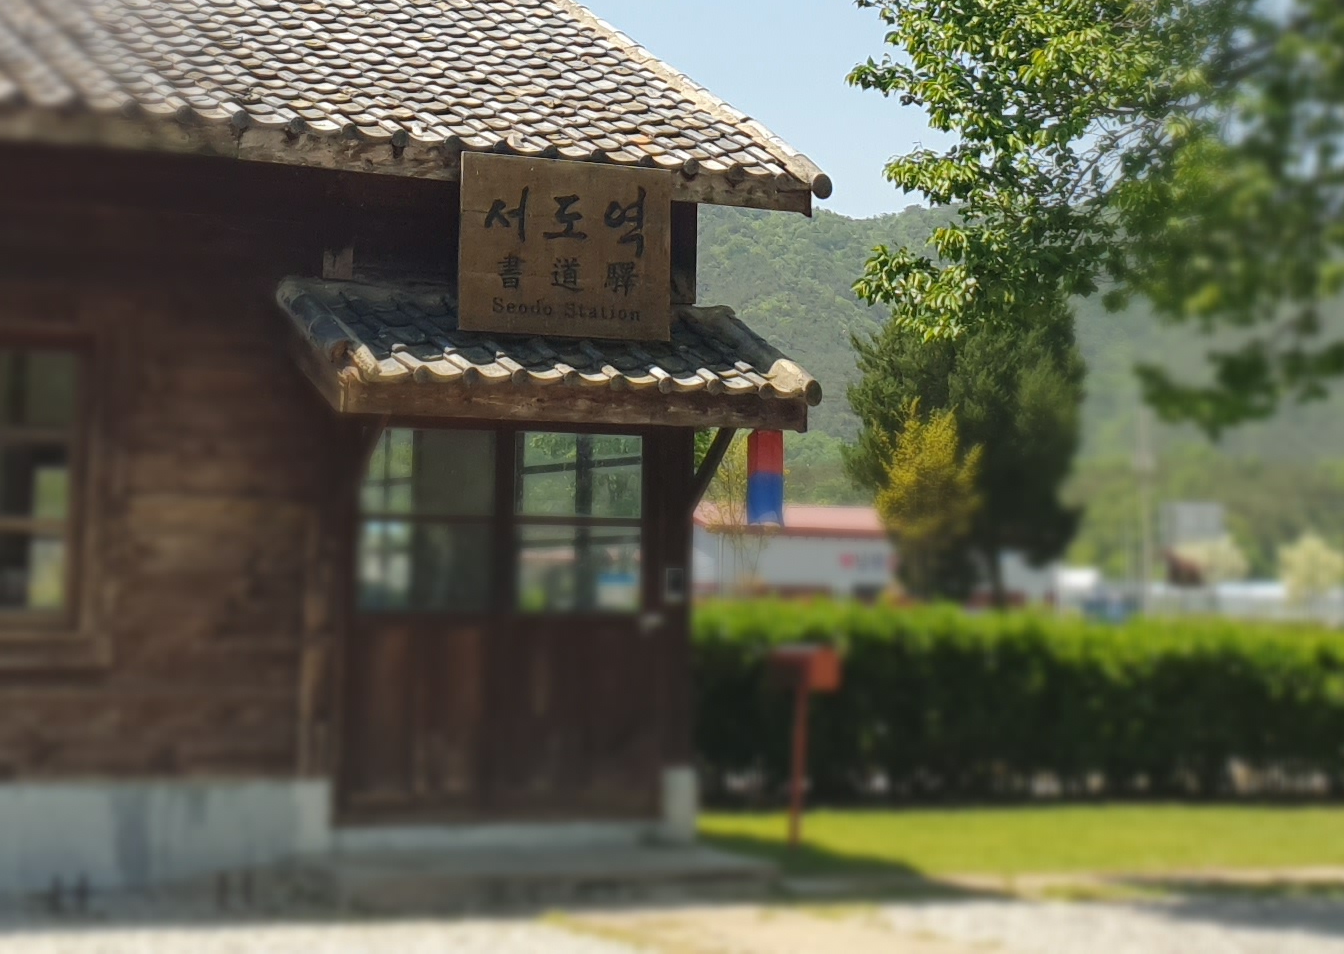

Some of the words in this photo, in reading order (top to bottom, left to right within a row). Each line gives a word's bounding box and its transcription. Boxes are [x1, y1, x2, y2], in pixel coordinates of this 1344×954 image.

[484, 185, 647, 258] 서도역
[497, 254, 639, 296] 書道驛
[492, 297, 553, 316] Seodo
[564, 302, 641, 322] Station
